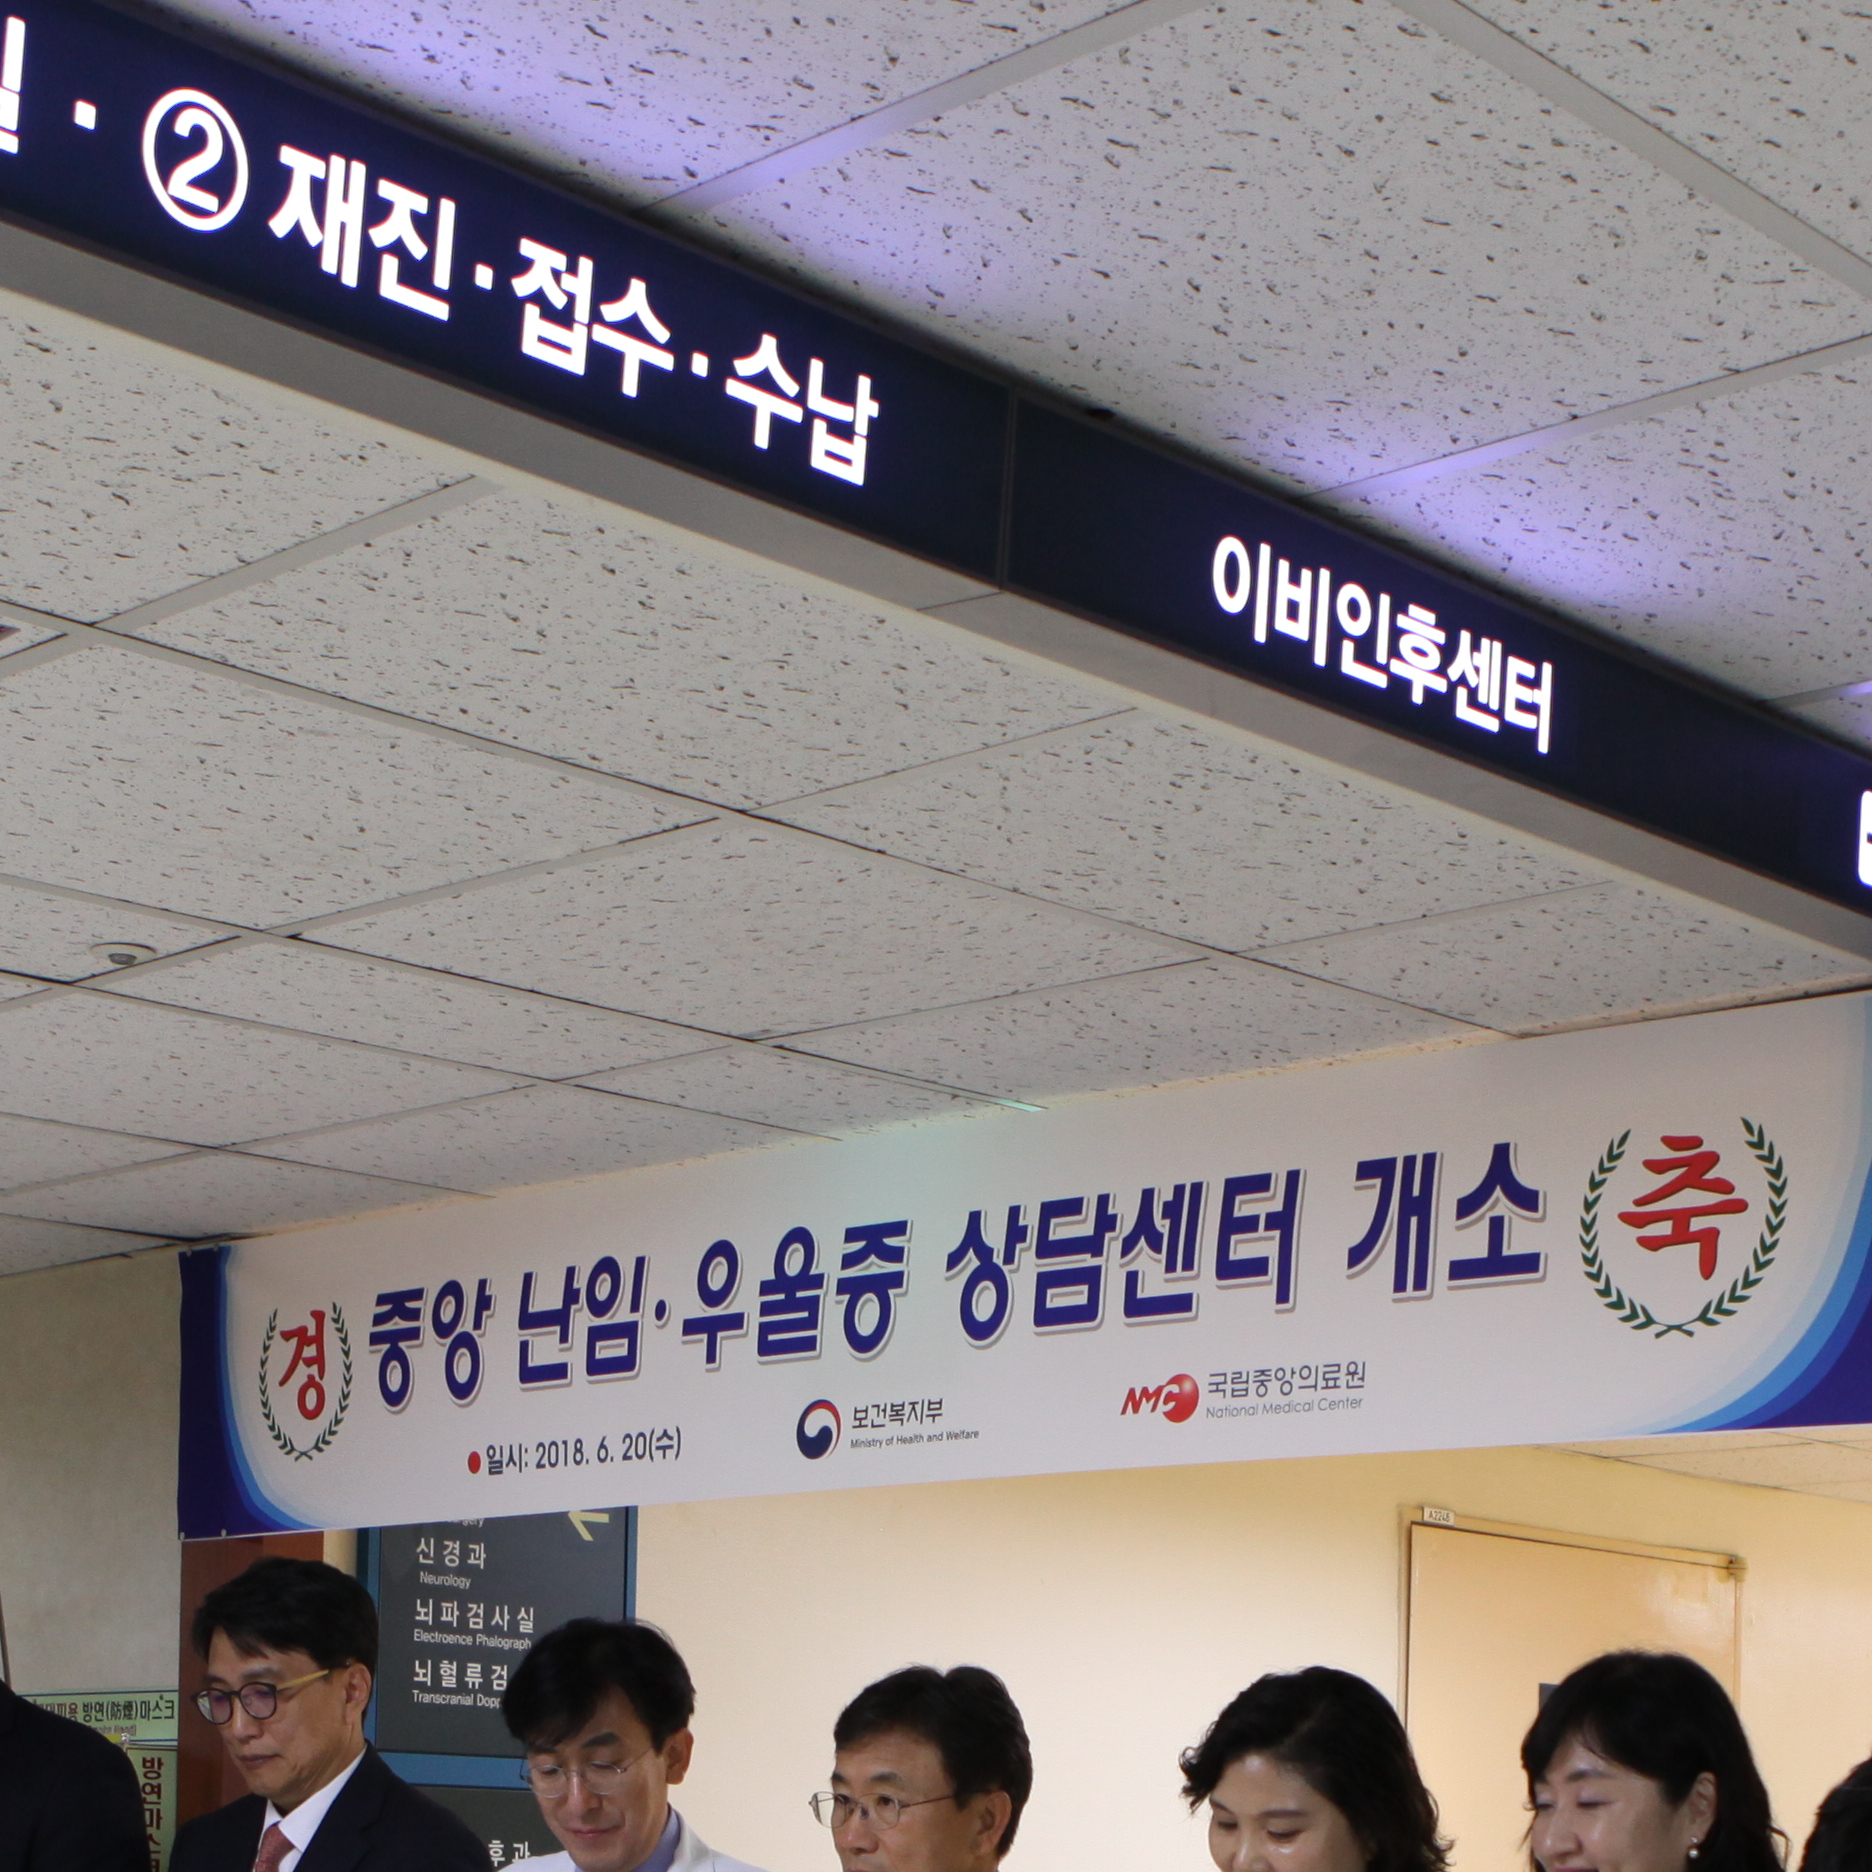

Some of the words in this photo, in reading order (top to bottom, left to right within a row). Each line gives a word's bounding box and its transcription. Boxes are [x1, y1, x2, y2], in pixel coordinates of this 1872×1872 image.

[266, 140, 880, 488] 재진·접수·수납
[1211, 535, 1554, 755] 이비인후센터
[1617, 1134, 1749, 1281] 축
[368, 1277, 495, 1410] 중앙
[517, 1219, 912, 1391] 난임·우울증
[944, 1168, 1308, 1351] 상담센터
[1346, 1141, 1548, 1303] 개소
[277, 1308, 329, 1422] 경
[1207, 1361, 1367, 1399] 국립중앙의료원
[851, 1397, 944, 1430] 보건복지부
[1206, 1404, 1259, 1419] National
[1261, 1400, 1315, 1415] Medical
[1317, 1397, 1363, 1412] Center
[486, 1440, 529, 1475] 일시:
[534, 1437, 592, 1470] 2018.
[596, 1435, 615, 1464] 6.
[621, 1426, 682, 1463] 20(수)
[850, 1437, 884, 1450] Ministry
[885, 1436, 895, 1445] of
[896, 1433, 924, 1445] Health
[926, 1431, 943, 1443] and
[945, 1429, 980, 1441] Welfare
[416, 1537, 487, 1570] 신경과
[419, 1571, 472, 1590] Neurology
[413, 1629, 474, 1646] Electroence
[476, 1634, 532, 1651] Phalograph
[412, 1690, 474, 1707] Transcranial
